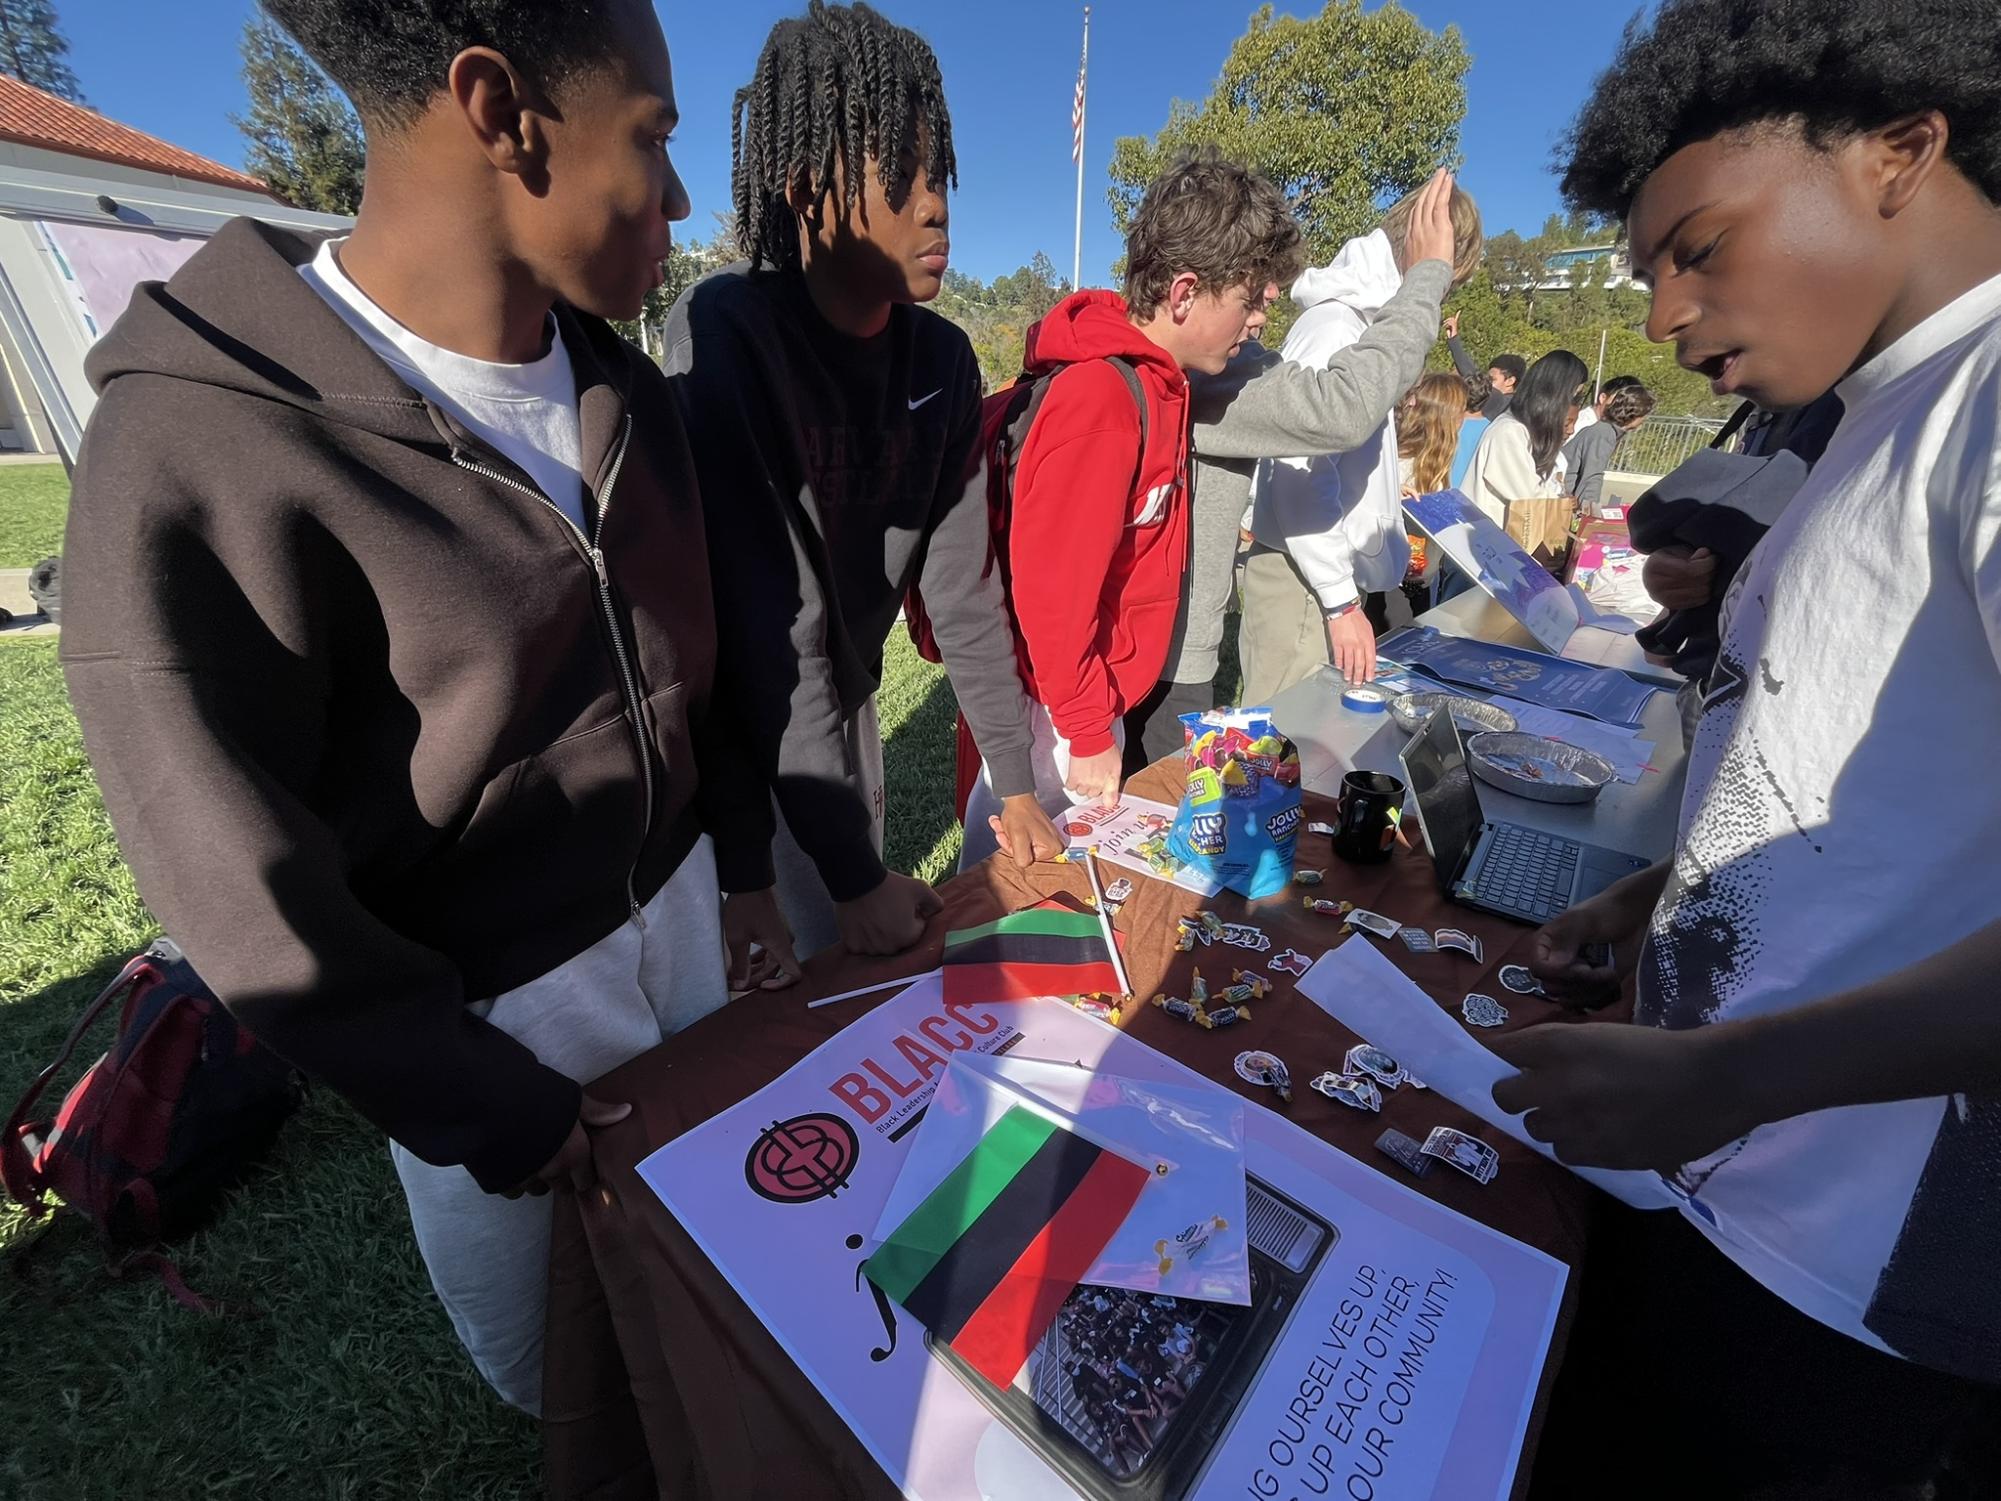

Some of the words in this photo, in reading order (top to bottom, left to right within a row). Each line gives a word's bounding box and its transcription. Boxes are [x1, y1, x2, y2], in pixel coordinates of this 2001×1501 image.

[828, 1003, 999, 1125] BLACC
[875, 1114, 900, 1134] Black
[895, 1086, 937, 1117] Leadership
[977, 1035, 1001, 1053] Culture
[997, 1025, 1014, 1037] Club
[1268, 1299, 1364, 1467] OURSELVES
[1349, 1264, 1387, 1299] UP,
[1300, 1444, 1335, 1494] UP
[1324, 1359, 1378, 1445] EACH
[1363, 1275, 1420, 1359] OTHER,
[1346, 1427, 1394, 1501] OUR
[1378, 1267, 1459, 1426] COMMUNITY!
